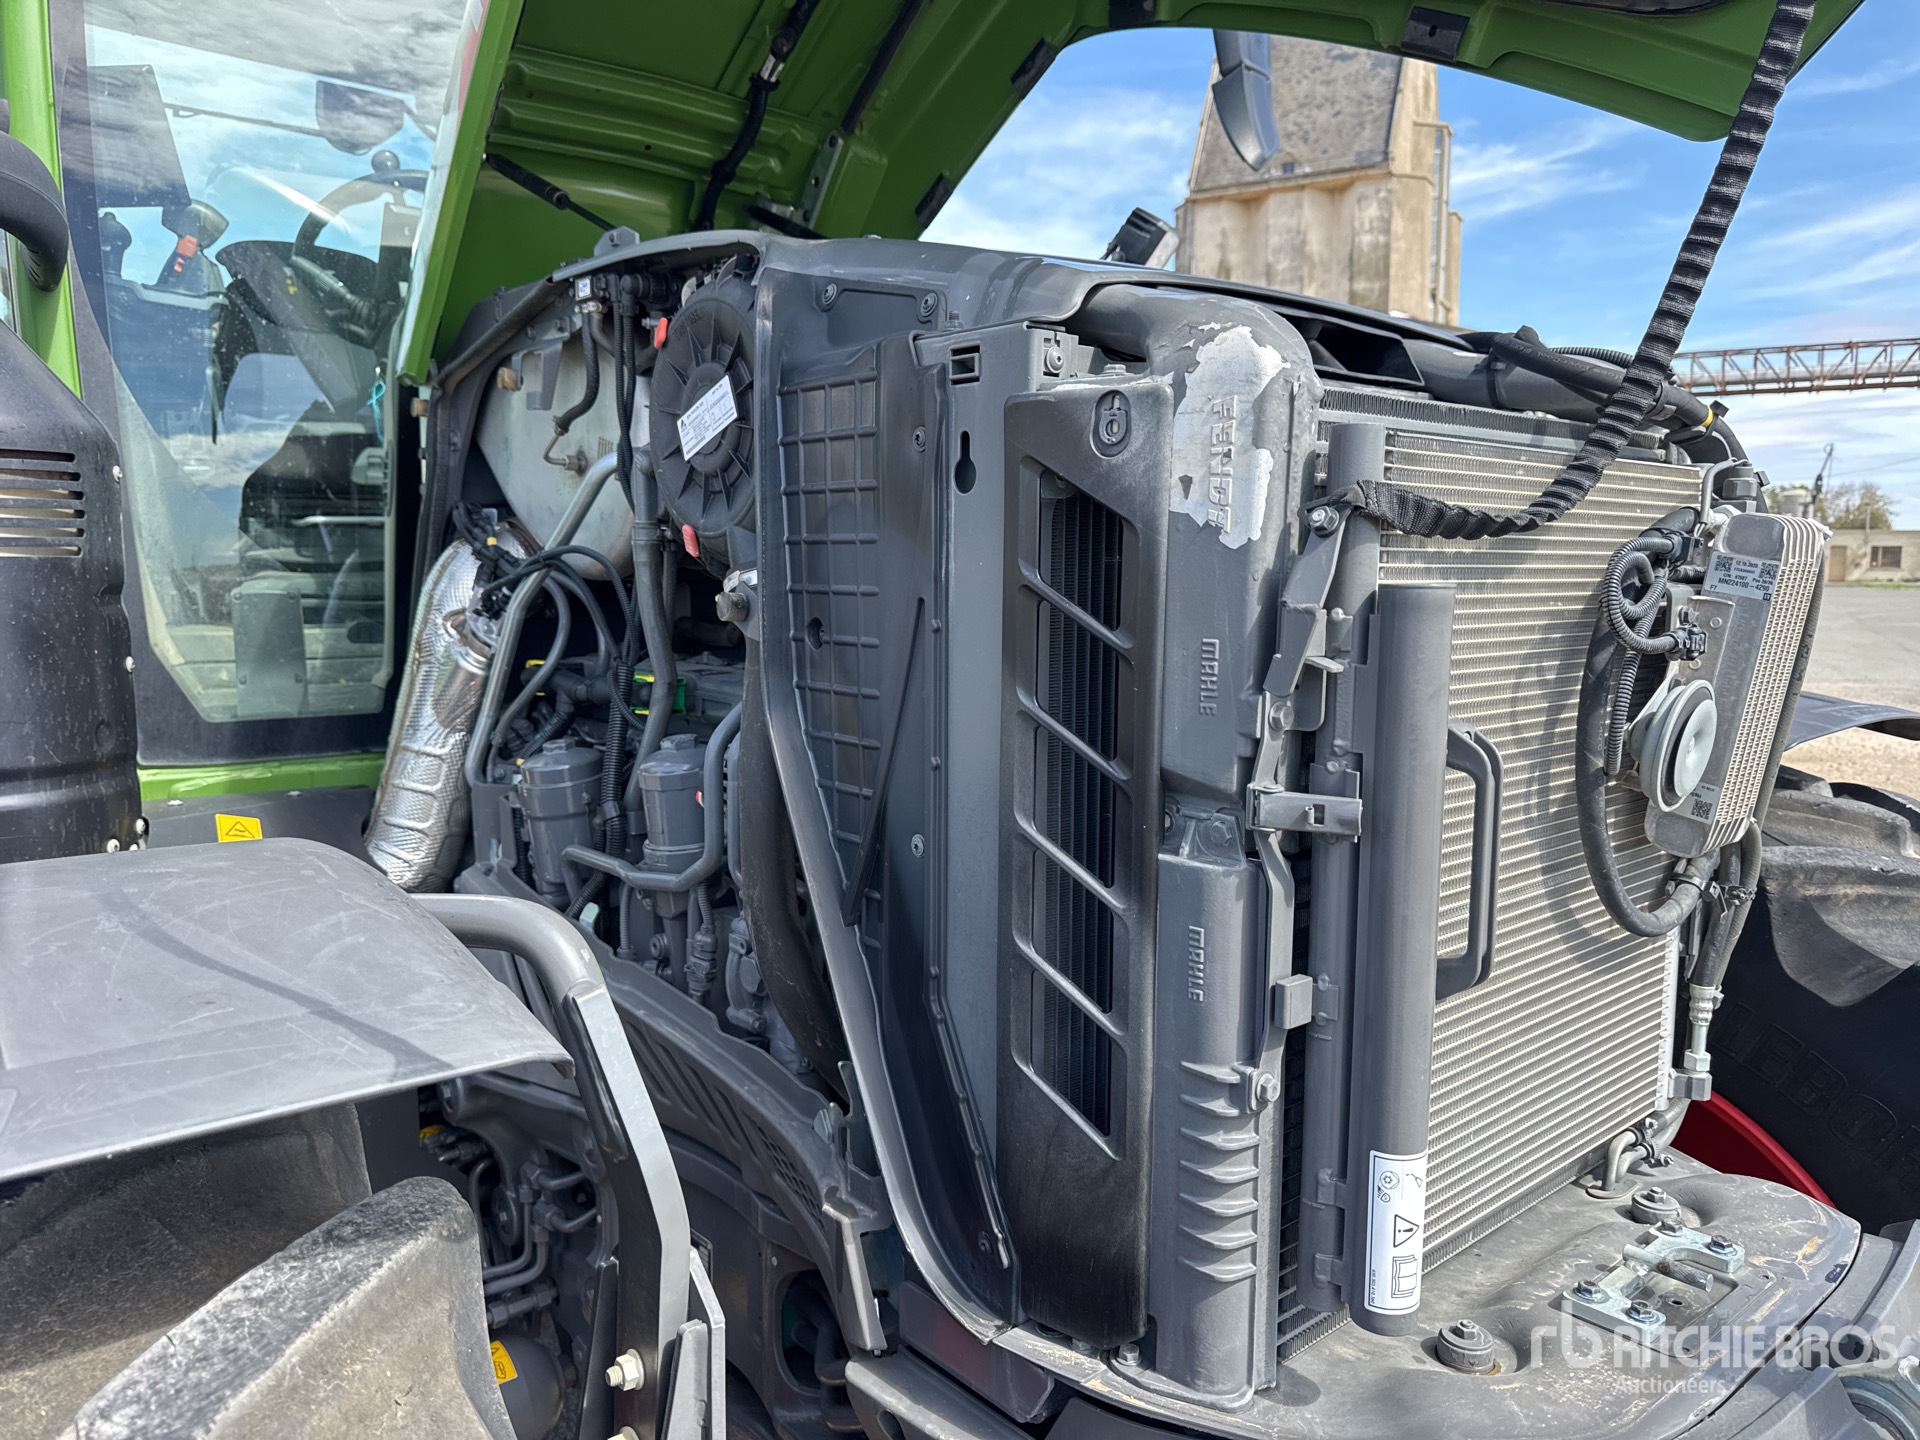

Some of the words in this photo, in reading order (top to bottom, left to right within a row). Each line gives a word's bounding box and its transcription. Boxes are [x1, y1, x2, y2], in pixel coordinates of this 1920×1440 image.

[1207, 395, 1238, 534] FENDT
[1200, 638, 1219, 716] MAHLE
[1188, 926, 1204, 1002] MAHLE
